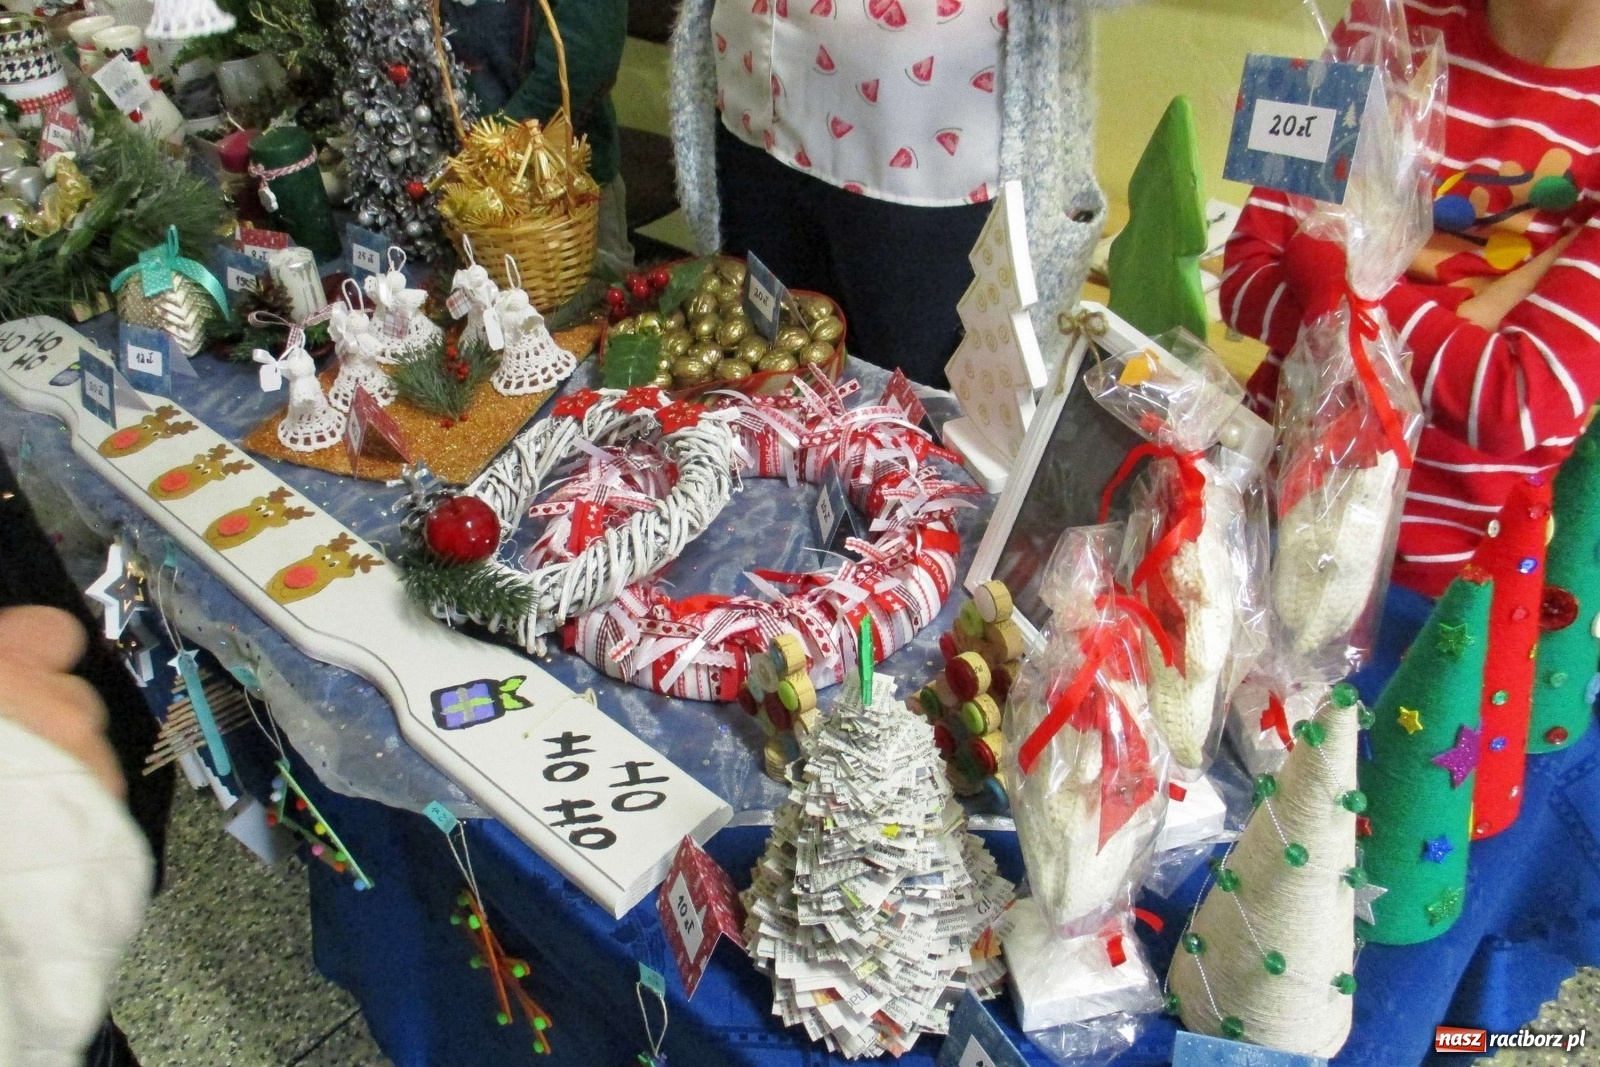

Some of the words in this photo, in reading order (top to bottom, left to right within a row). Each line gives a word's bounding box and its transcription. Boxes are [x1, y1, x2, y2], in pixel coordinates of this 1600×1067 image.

[25, 331, 64, 353] HO
[7, 352, 49, 371] HO
[542, 731, 598, 783] HO
[608, 760, 671, 813] HO
[542, 798, 618, 851] HO
[677, 895, 688, 917] 10
